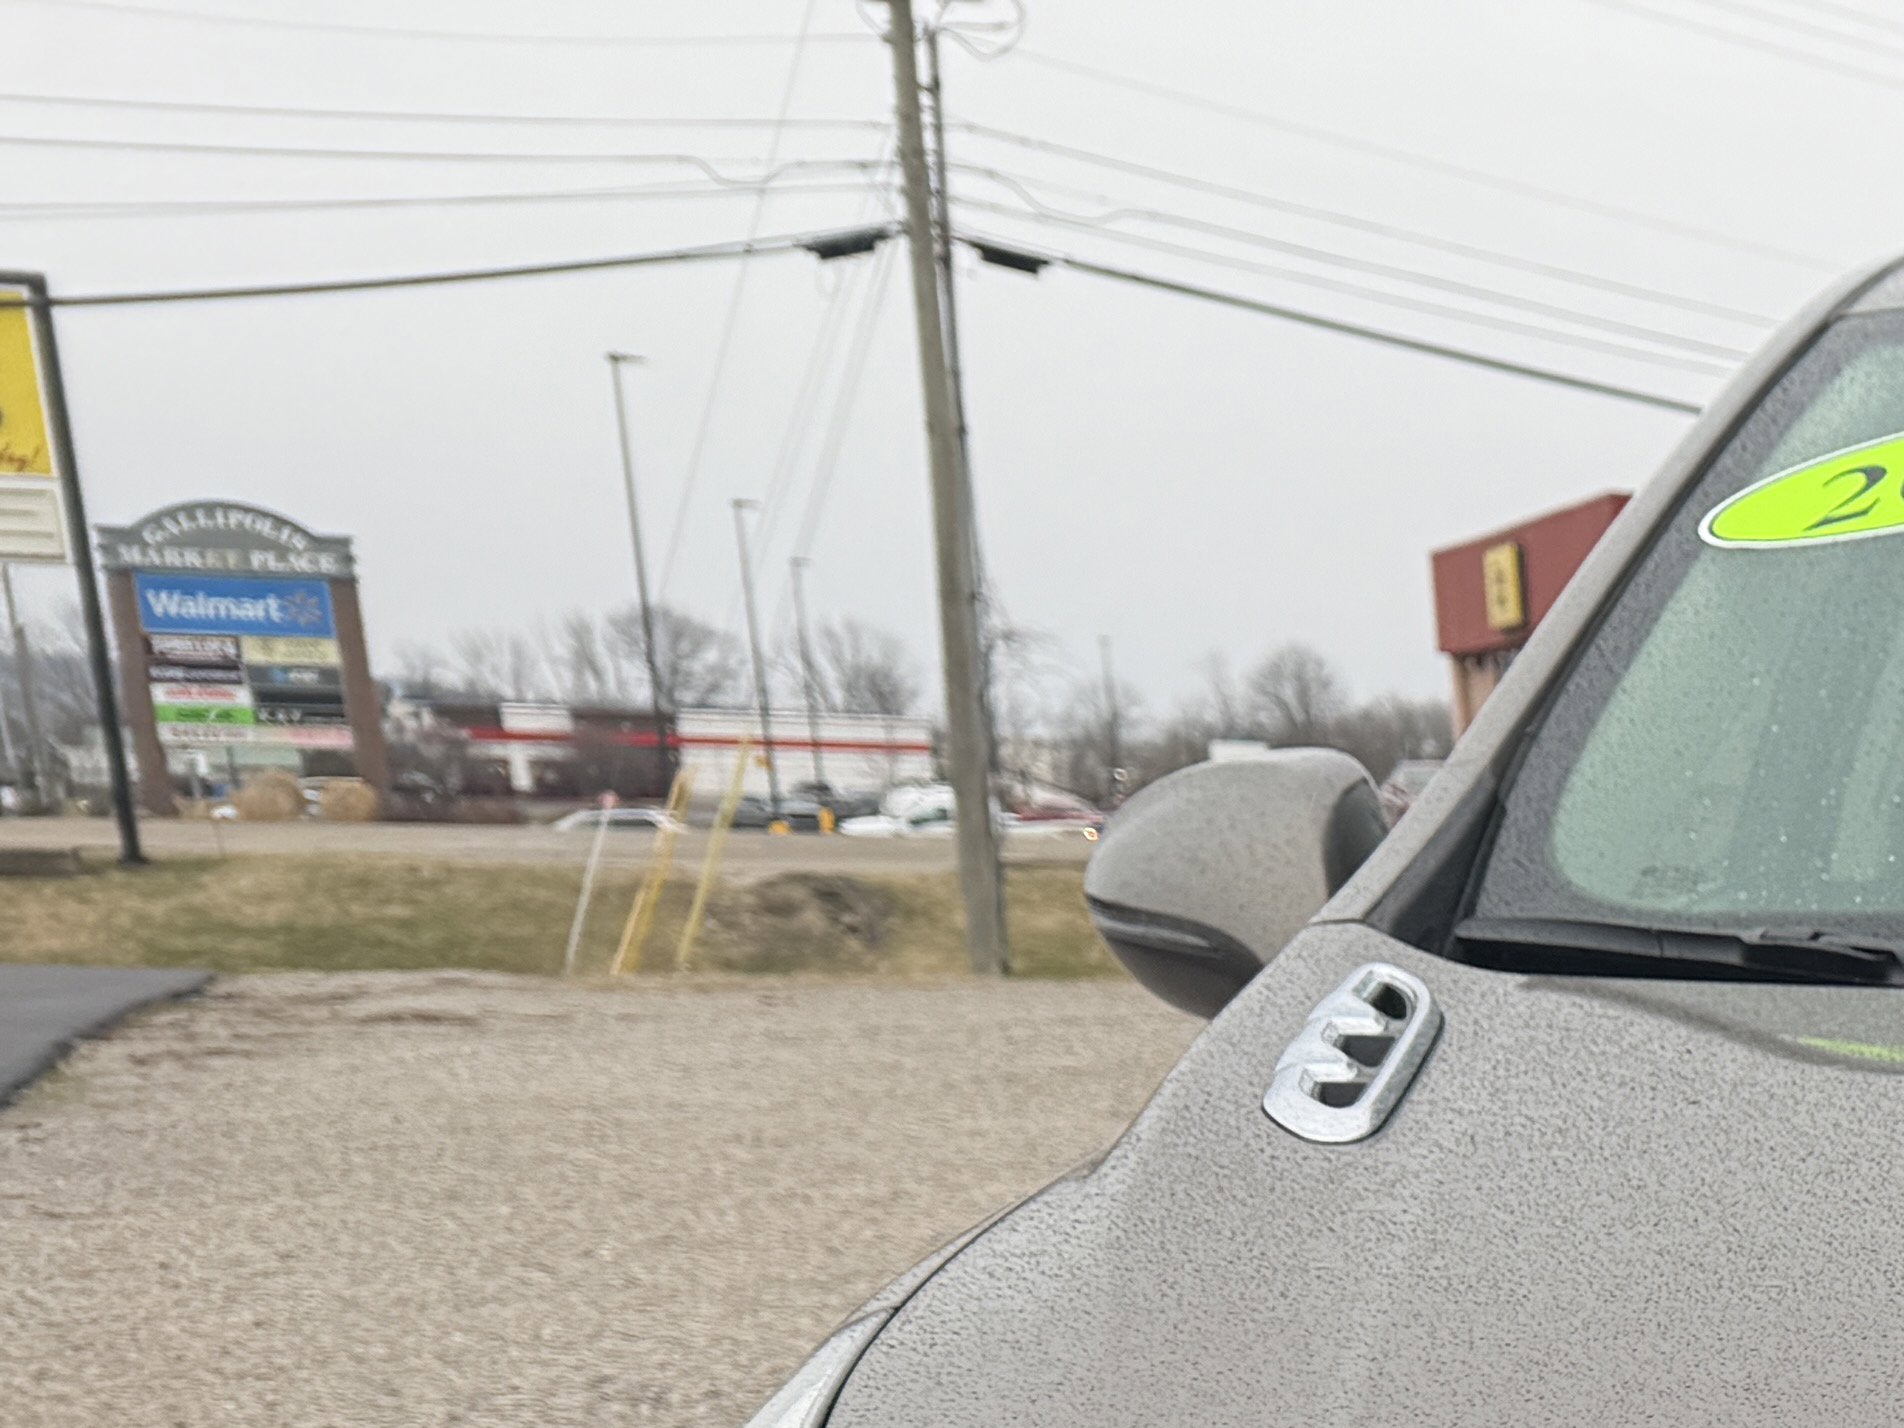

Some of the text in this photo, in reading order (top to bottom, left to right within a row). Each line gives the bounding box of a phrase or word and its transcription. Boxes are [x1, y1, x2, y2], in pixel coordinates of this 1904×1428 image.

[142, 507, 307, 549] GALLIPOLIS
[117, 545, 338, 573] MARKET PLACE
[146, 587, 283, 624] Walmart
